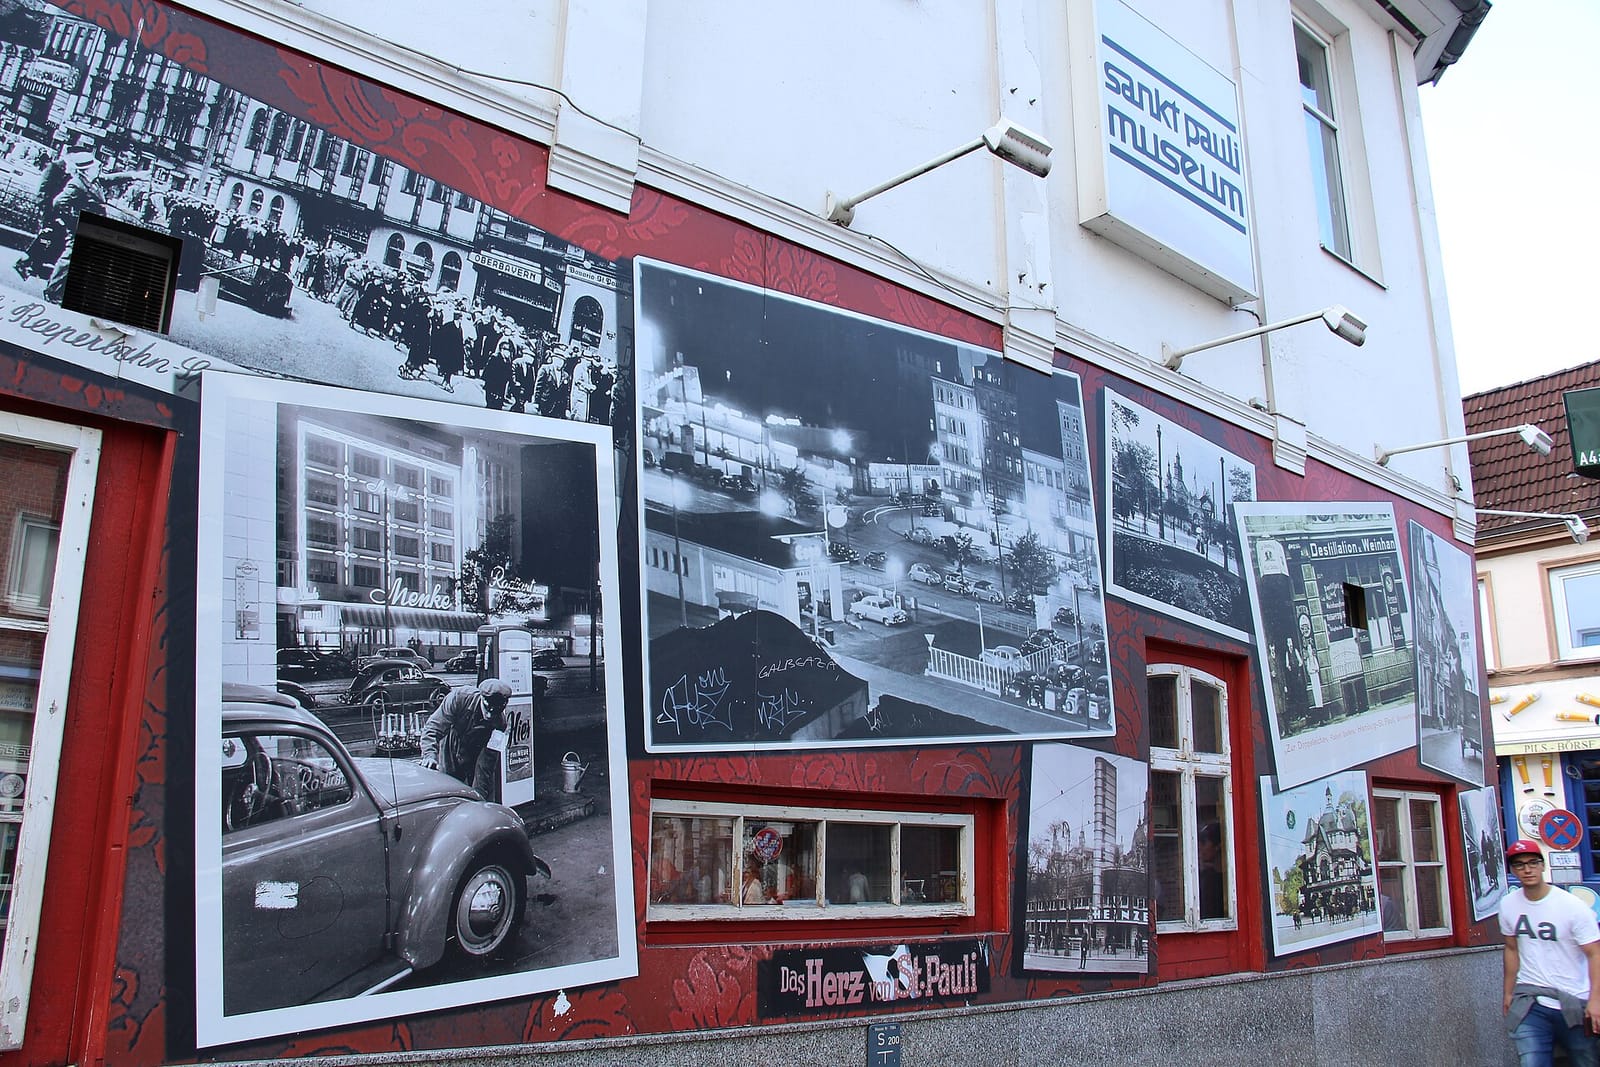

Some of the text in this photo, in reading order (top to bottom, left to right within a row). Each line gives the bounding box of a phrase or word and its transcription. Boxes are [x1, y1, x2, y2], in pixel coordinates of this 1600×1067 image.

[1104, 61, 1240, 175] sankt pauli
[1108, 104, 1244, 217] museum
[1310, 540, 1358, 557] Destillation
[369, 577, 452, 609] Menke
[1515, 914, 1557, 941] Aa
[780, 966, 805, 995] Das
[805, 958, 865, 1008] Herz
[869, 980, 891, 1001] von
[877, 1032, 900, 1046] S 200
